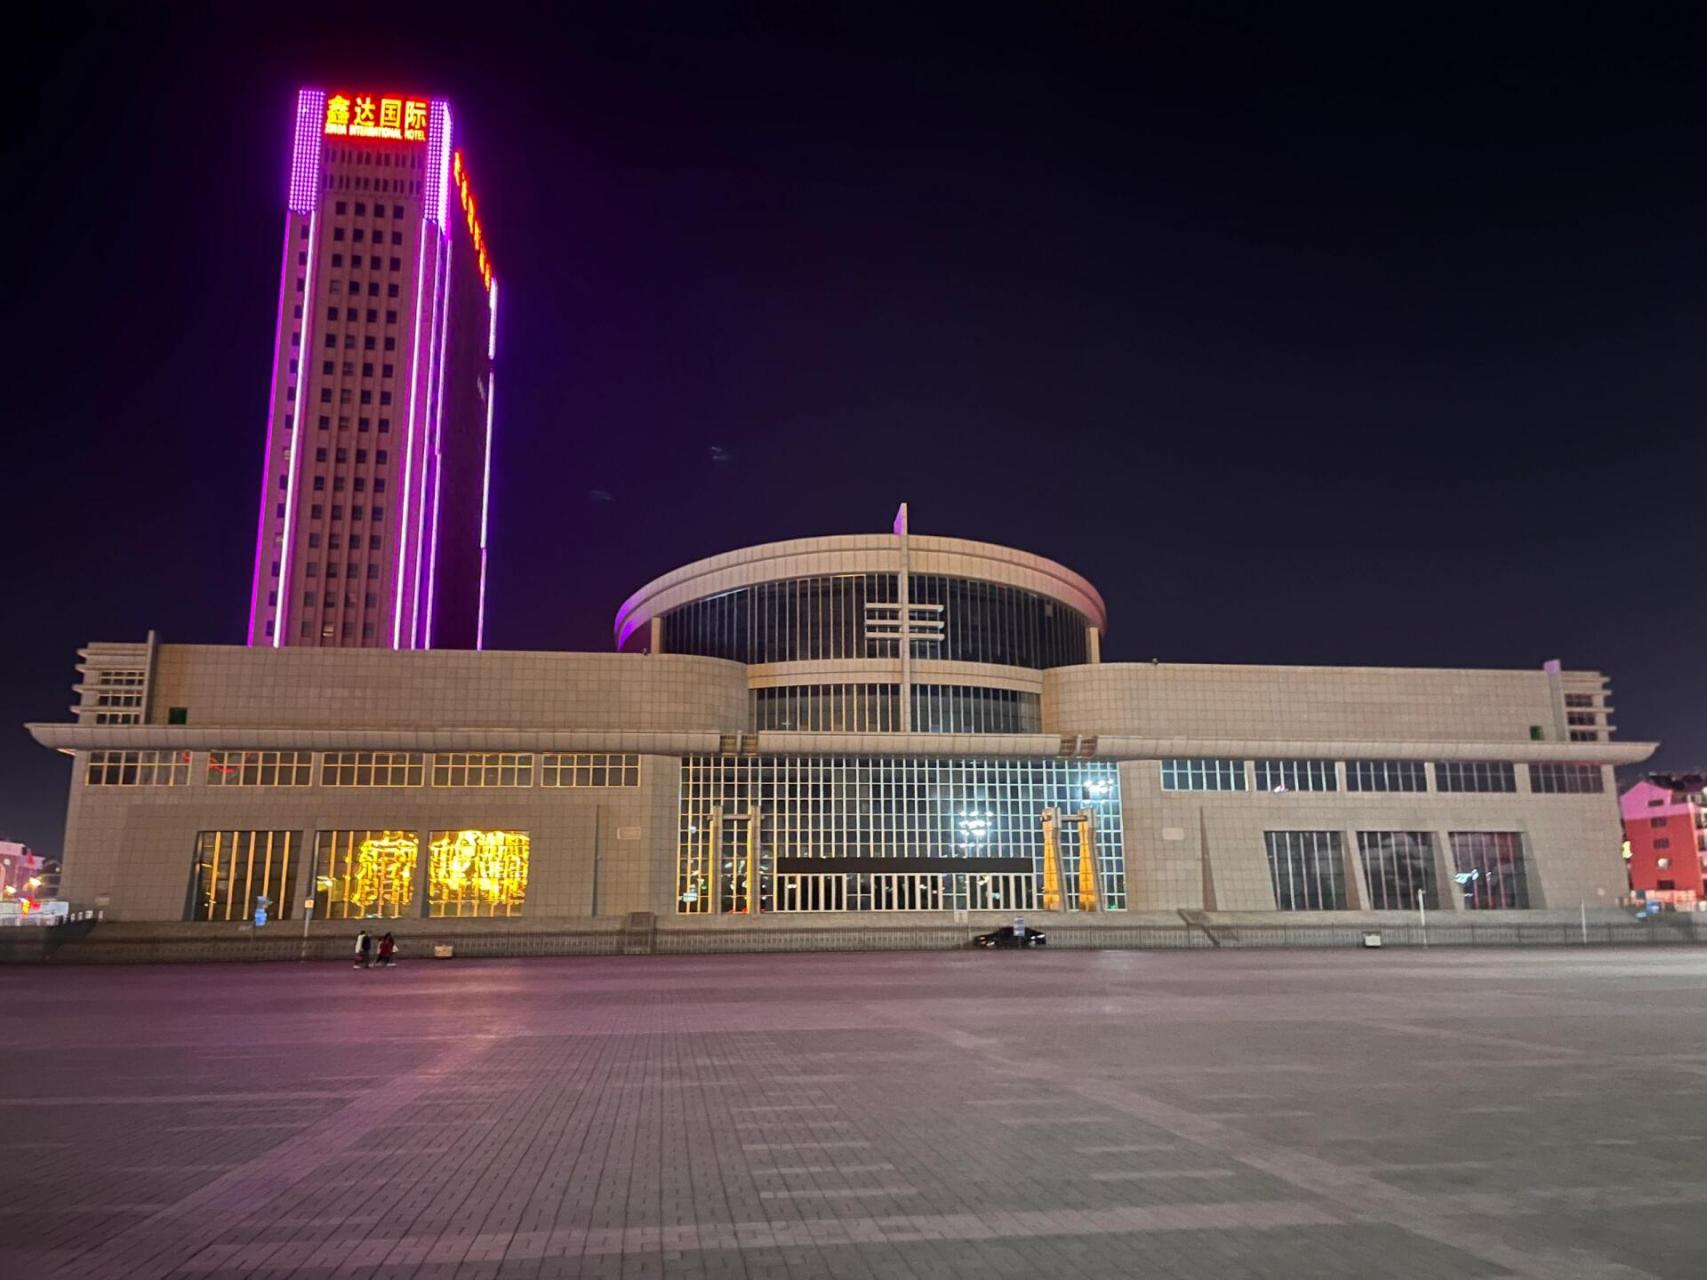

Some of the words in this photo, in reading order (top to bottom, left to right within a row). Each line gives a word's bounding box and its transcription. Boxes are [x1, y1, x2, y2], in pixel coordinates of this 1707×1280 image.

[327, 95, 427, 129] 鑫达国际
[404, 129, 426, 142] HOTEL
